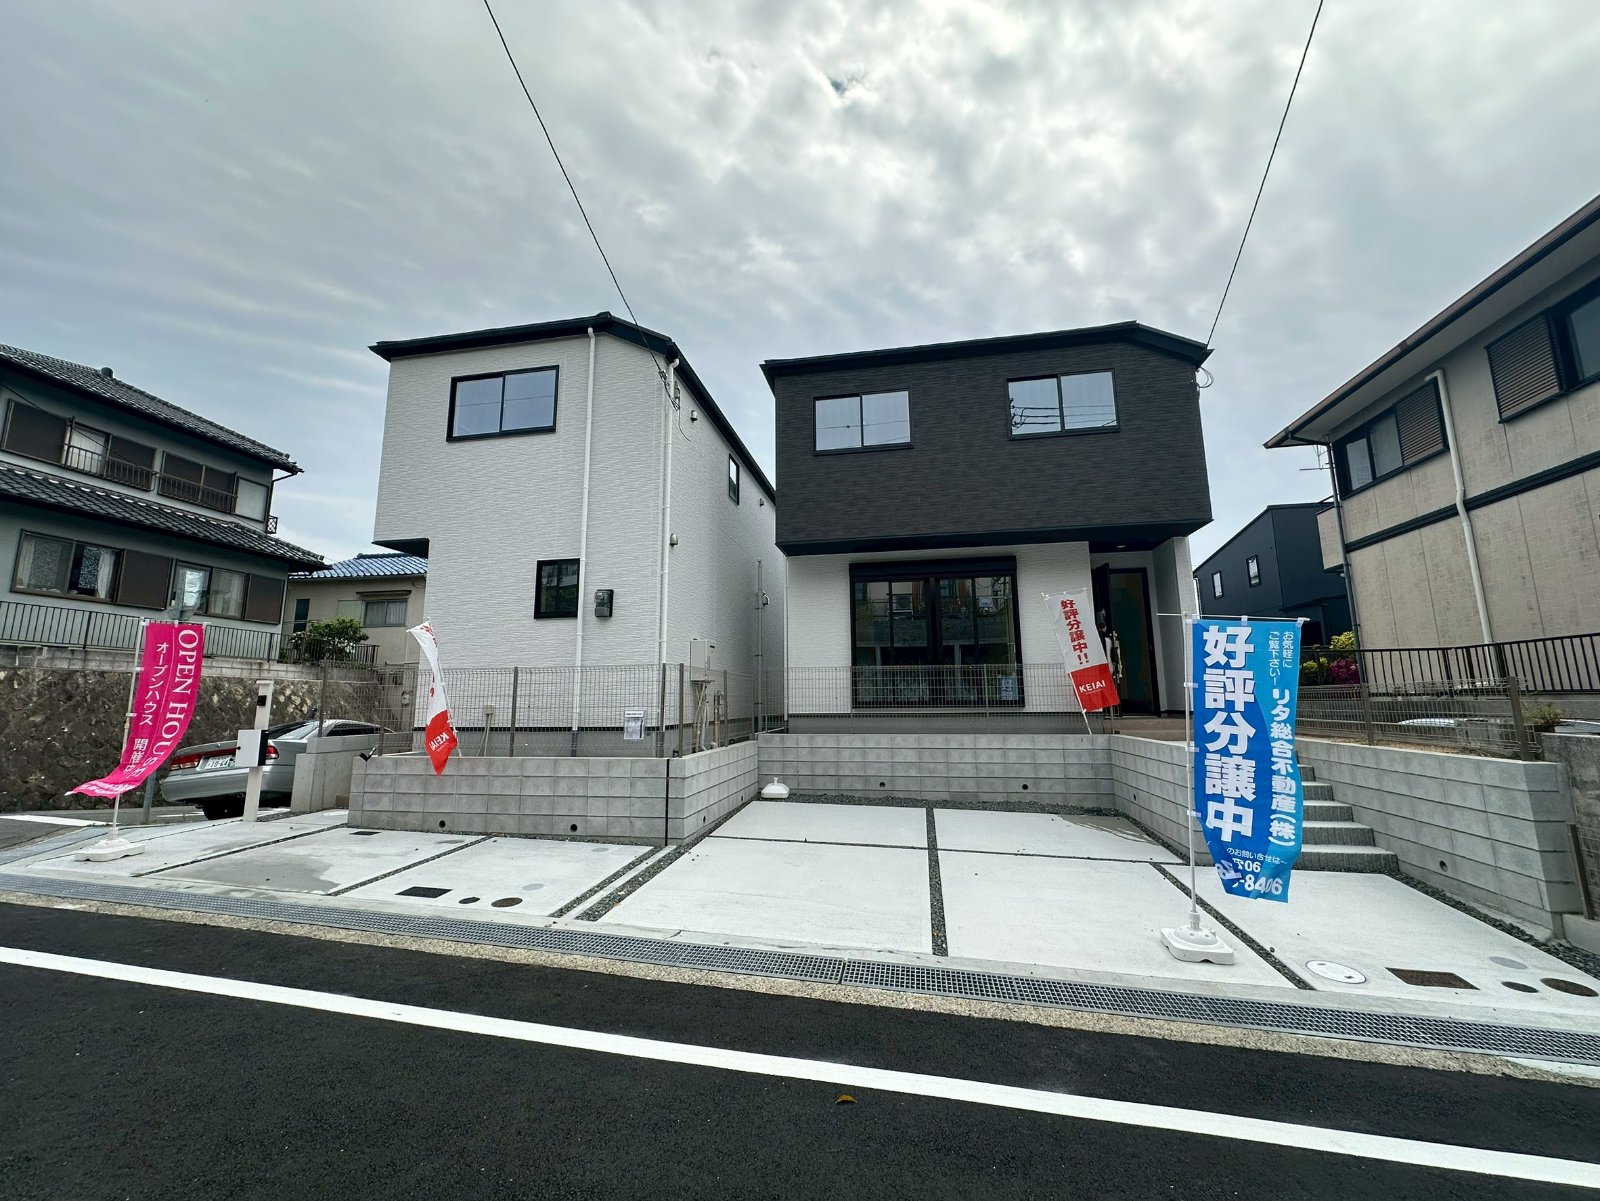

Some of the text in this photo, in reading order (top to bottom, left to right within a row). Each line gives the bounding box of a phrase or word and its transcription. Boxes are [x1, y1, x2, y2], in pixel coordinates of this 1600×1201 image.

[173, 629, 199, 695] OPEN
[1060, 599, 1089, 665] 好評分譲中!!
[1282, 631, 1294, 668] お気軽に
[139, 642, 169, 726] オープンハウス
[1079, 679, 1106, 693] KEIAI
[1203, 625, 1257, 843] 好評分譲中
[1268, 688, 1297, 847] リタ総合不動産(株)
